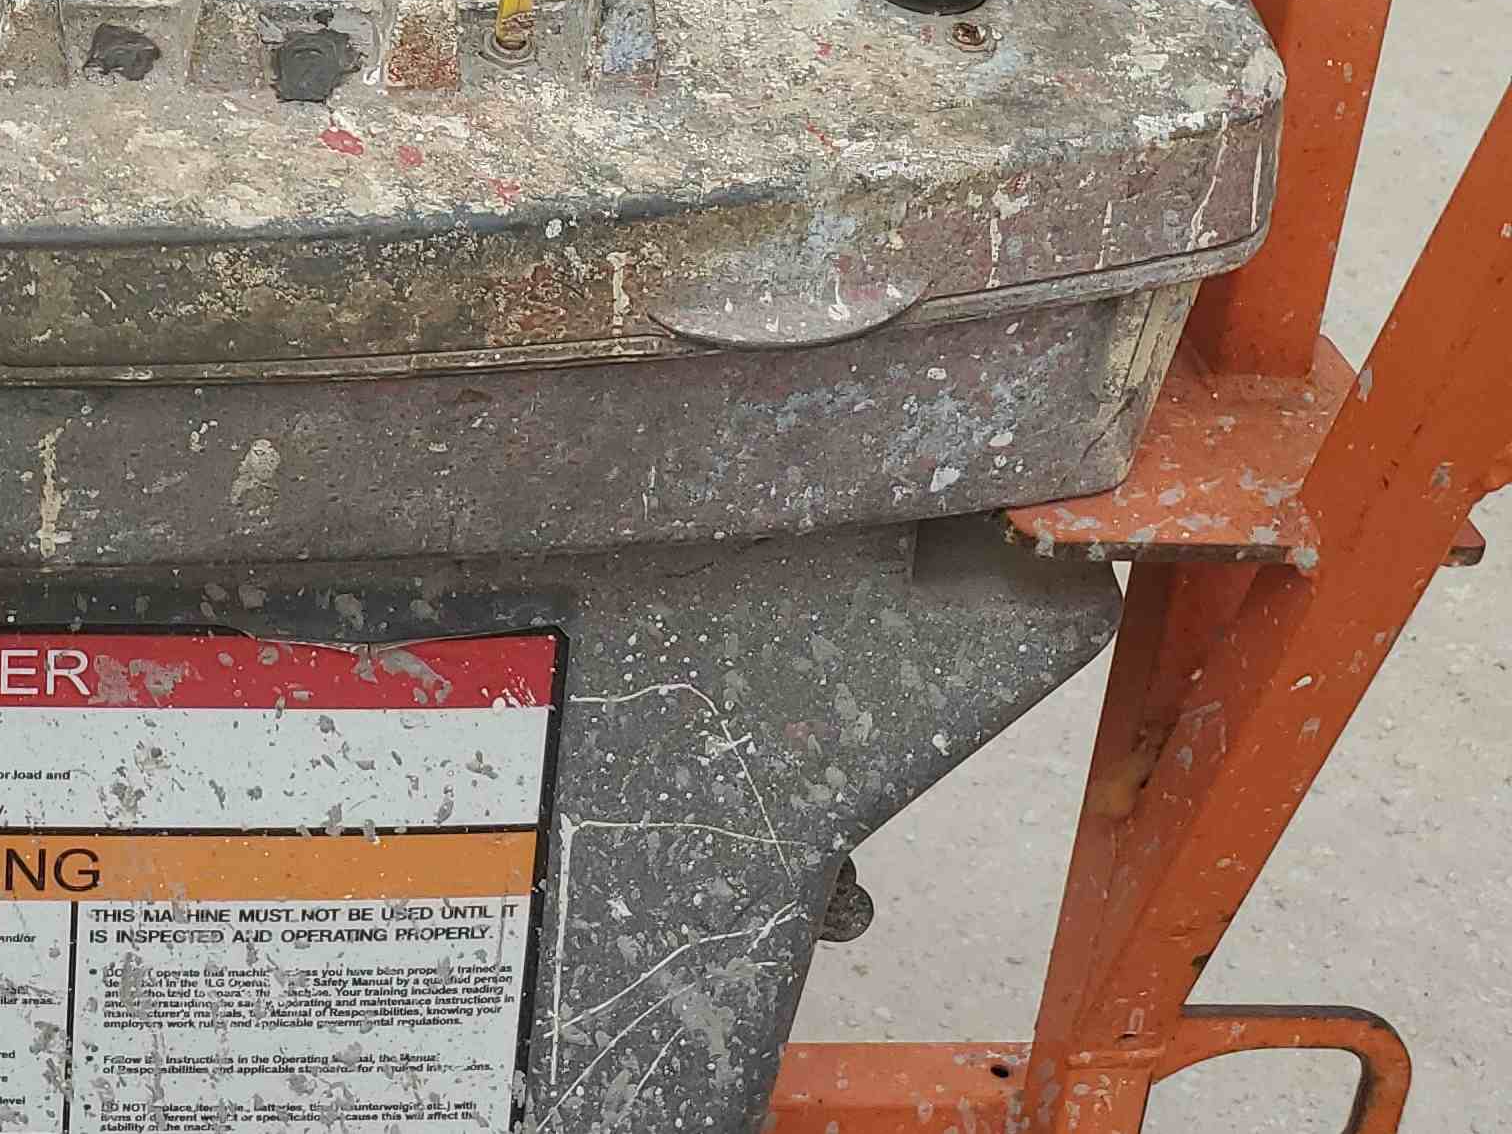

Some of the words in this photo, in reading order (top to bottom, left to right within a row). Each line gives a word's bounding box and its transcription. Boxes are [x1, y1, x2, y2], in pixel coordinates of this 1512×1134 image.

[12, 769, 42, 780] load
[46, 769, 71, 780] and
[90, 909, 136, 923] THIS
[143, 909, 231, 923] MAHINE
[237, 909, 294, 923] MUST
[301, 908, 340, 922] NOT
[348, 907, 374, 922] BE
[440, 905, 494, 920] UNTIL
[501, 904, 519, 918] IT
[88, 929, 109, 944] IS
[115, 929, 225, 944] INSPECTED
[280, 928, 388, 943] OPERATING
[395, 926, 494, 941] PROPERLY.
[457, 964, 496, 975] trained
[313, 977, 349, 989] Safety
[351, 976, 394, 987] Manual
[473, 976, 513, 986] person
[335, 987, 361, 997] Your
[364, 986, 409, 998] training
[411, 986, 458, 996] includes
[461, 984, 505, 996] reading
[335, 997, 357, 1007] and
[359, 996, 432, 1007] maintenance
[434, 994, 502, 1005] instructions
[270, 1008, 312, 1018] Manual
[329, 1006, 424, 1018] Responsibilities,
[426, 1005, 474, 1017] knowing
[103, 1020, 164, 1030] employers
[167, 1019, 194, 1028] work
[397, 1017, 463, 1028] regulations.
[272, 1054, 329, 1066] Operating
[237, 1065, 296, 1076] applicable
[100, 1122, 145, 1133] stability
